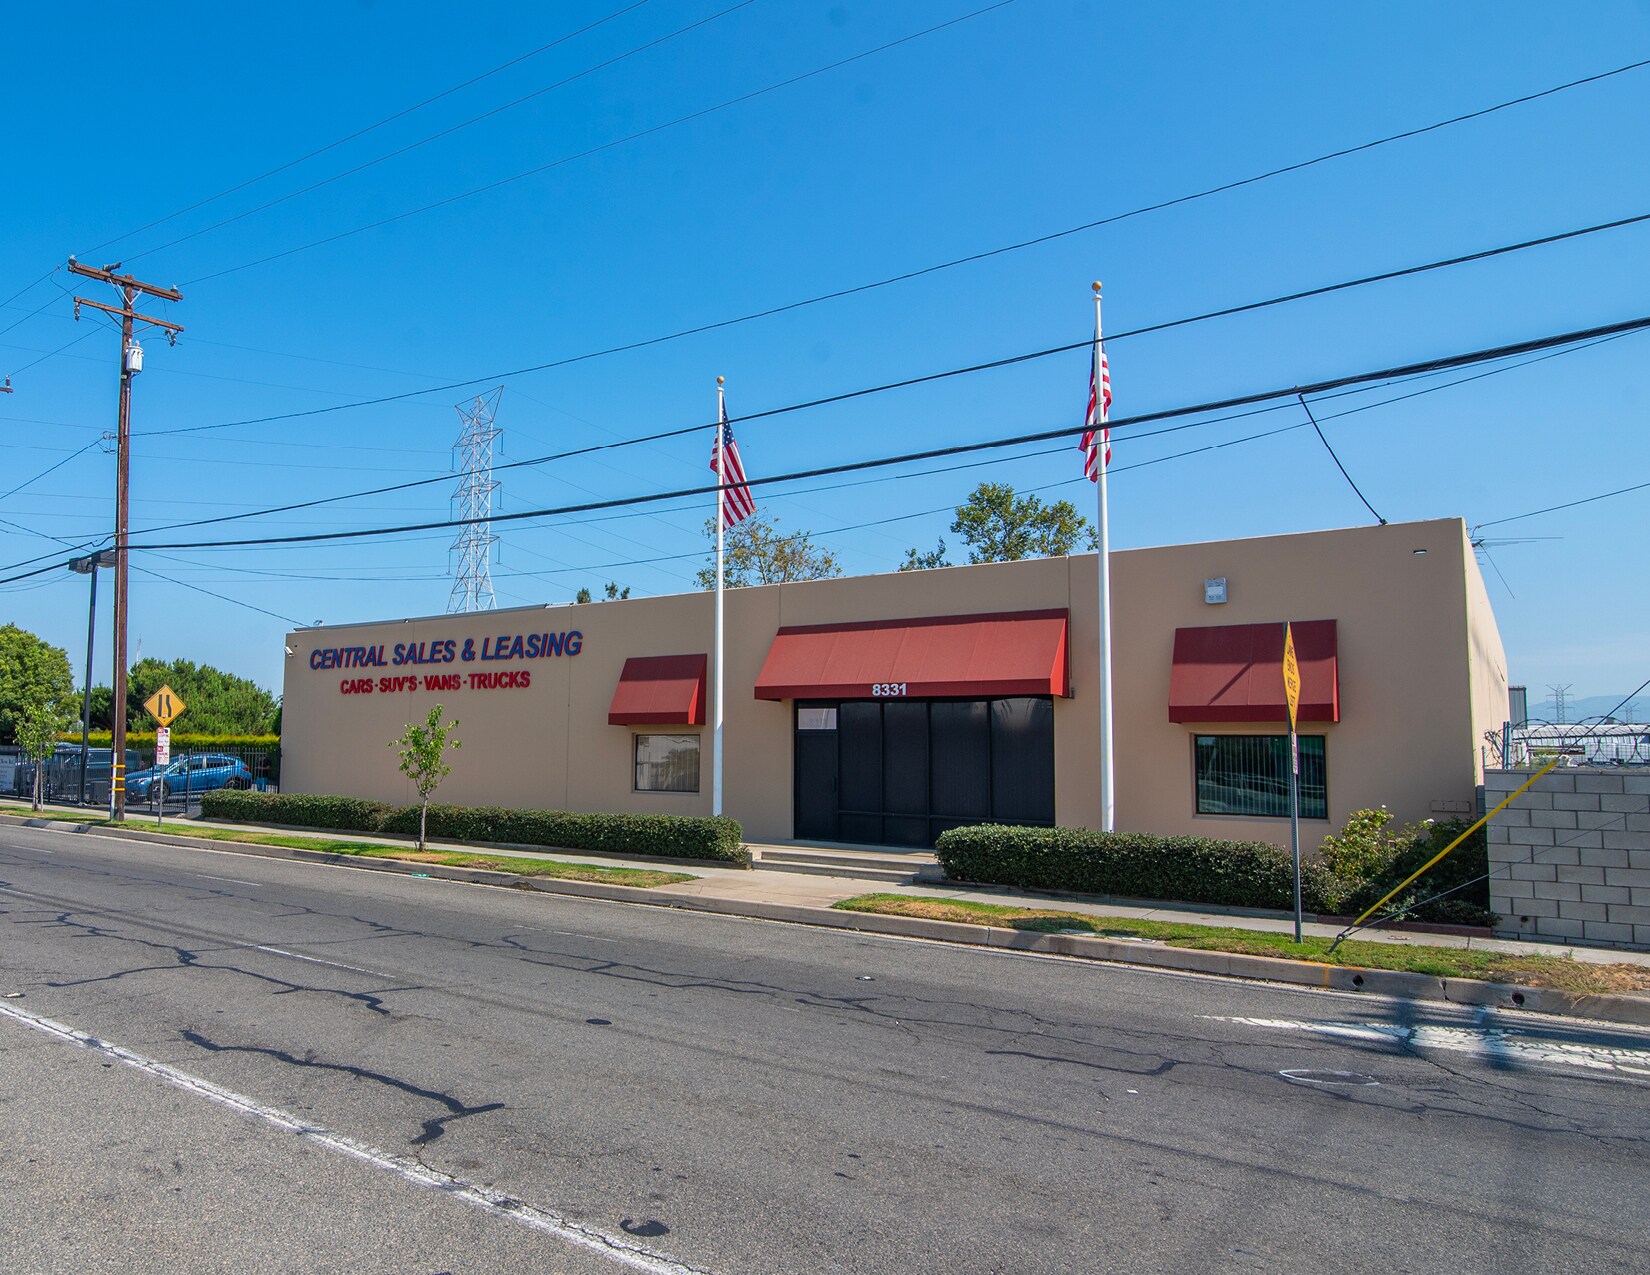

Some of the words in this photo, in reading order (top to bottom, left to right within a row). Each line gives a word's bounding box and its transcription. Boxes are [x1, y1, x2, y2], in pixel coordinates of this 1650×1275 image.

[309, 646, 388, 670] CENTRAL
[392, 638, 456, 665] SALES
[461, 638, 476, 662] &
[481, 630, 583, 660] LEASING
[468, 670, 531, 689] TRUCKS
[872, 683, 907, 696] 8331
